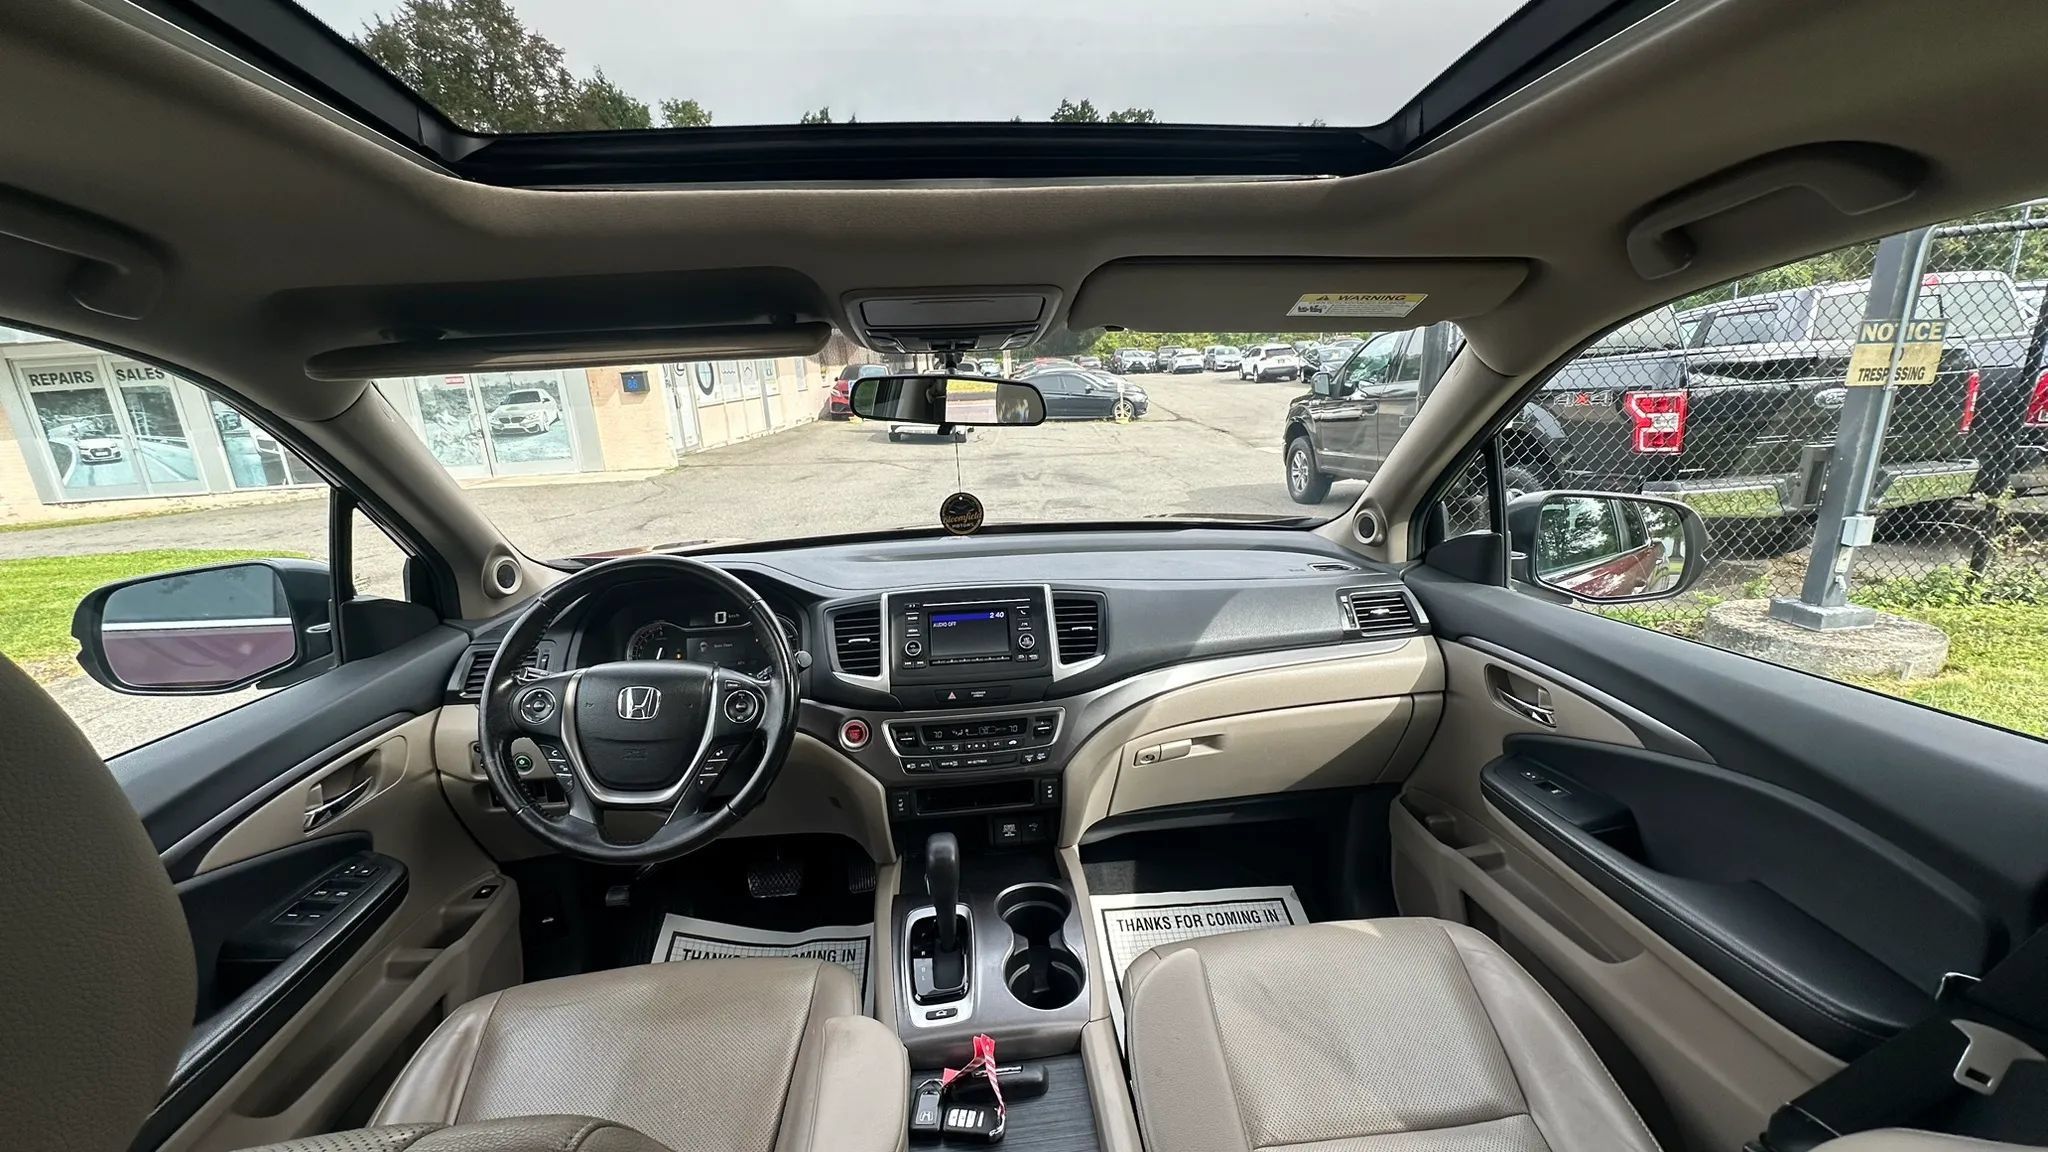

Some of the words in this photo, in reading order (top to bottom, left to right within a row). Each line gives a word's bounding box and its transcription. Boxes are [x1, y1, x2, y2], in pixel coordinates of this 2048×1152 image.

[1861, 322, 1945, 341] NOICE
[28, 370, 95, 387] REPAIRS
[116, 367, 165, 381] SALES
[1858, 366, 1926, 382] TRESPSSING
[1116, 916, 1172, 933] THANKS
[1174, 914, 1203, 929] FOR
[1207, 909, 1261, 927] COMING
[1264, 909, 1280, 923] IN
[842, 949, 857, 963] IN
